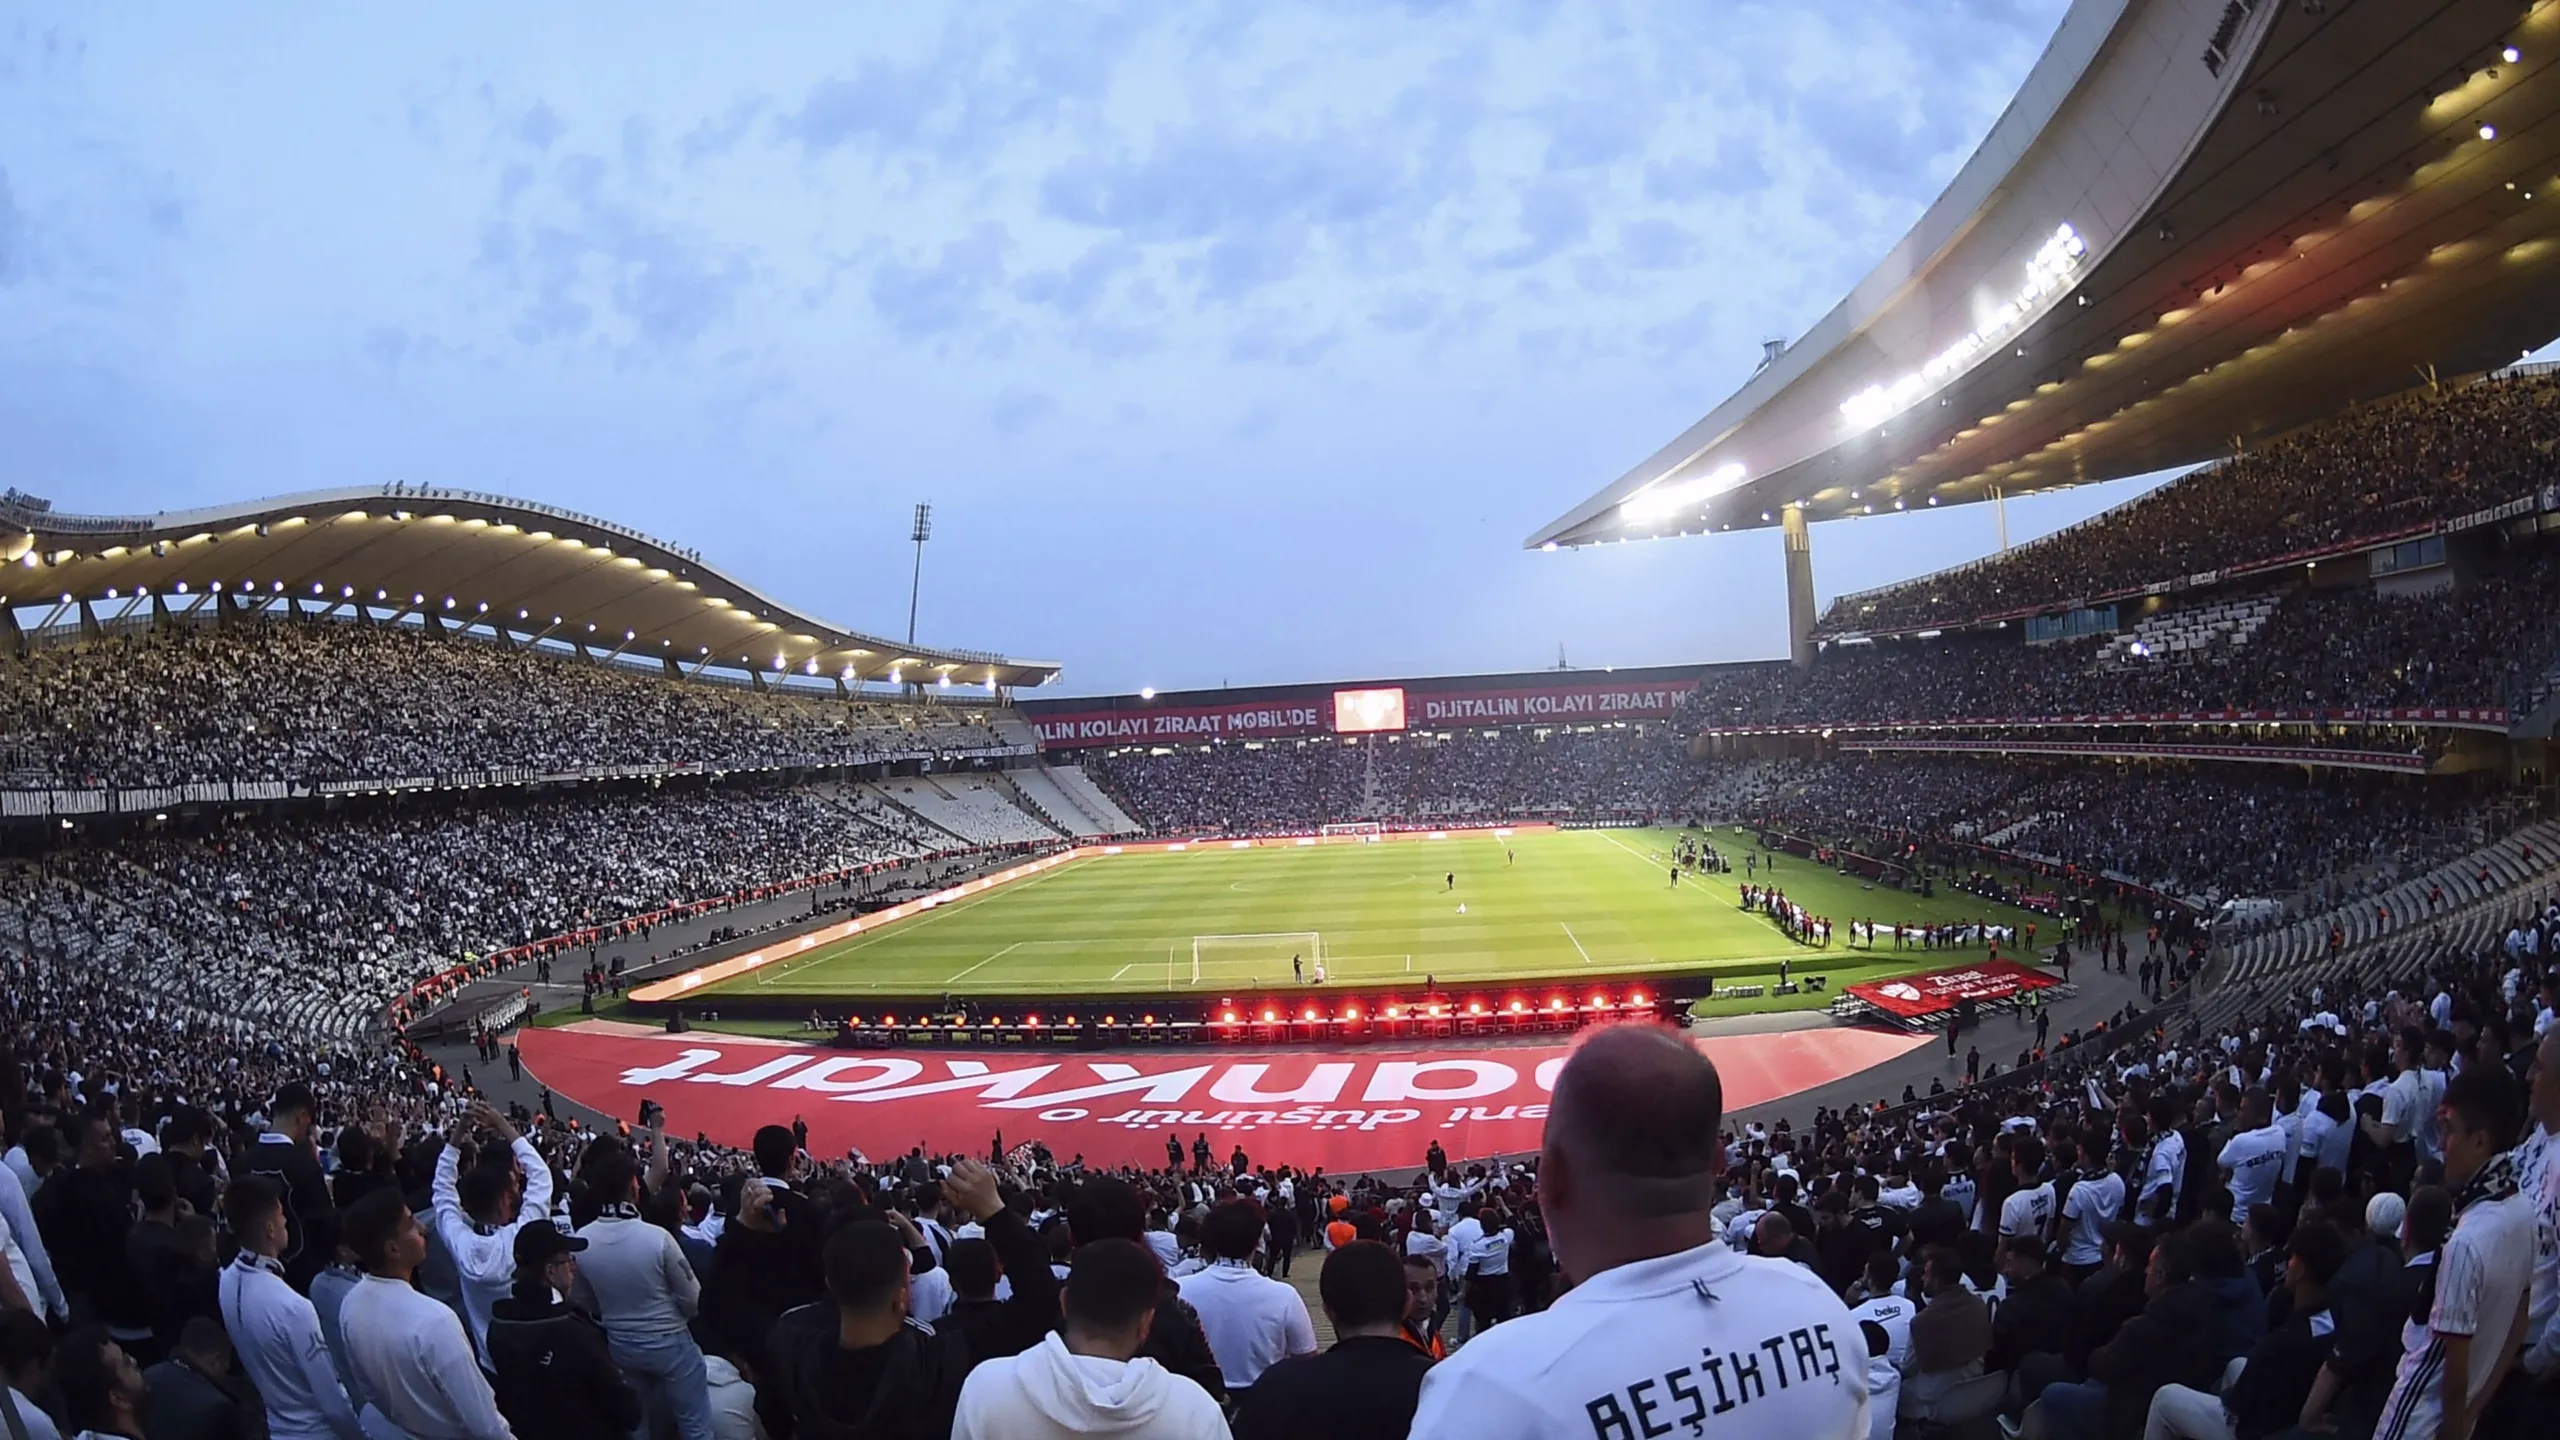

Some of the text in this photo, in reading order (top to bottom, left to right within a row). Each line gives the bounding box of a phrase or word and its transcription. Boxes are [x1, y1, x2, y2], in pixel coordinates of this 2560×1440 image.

[1524, 694, 1593, 715] KOLAYI
[1080, 716, 1148, 738] KOLAYI
[1038, 1103, 1552, 1131] eni düşünür o
[1874, 1304, 1901, 1317] beko
[1585, 1324, 1841, 1440] BEŞİKTAŞ
